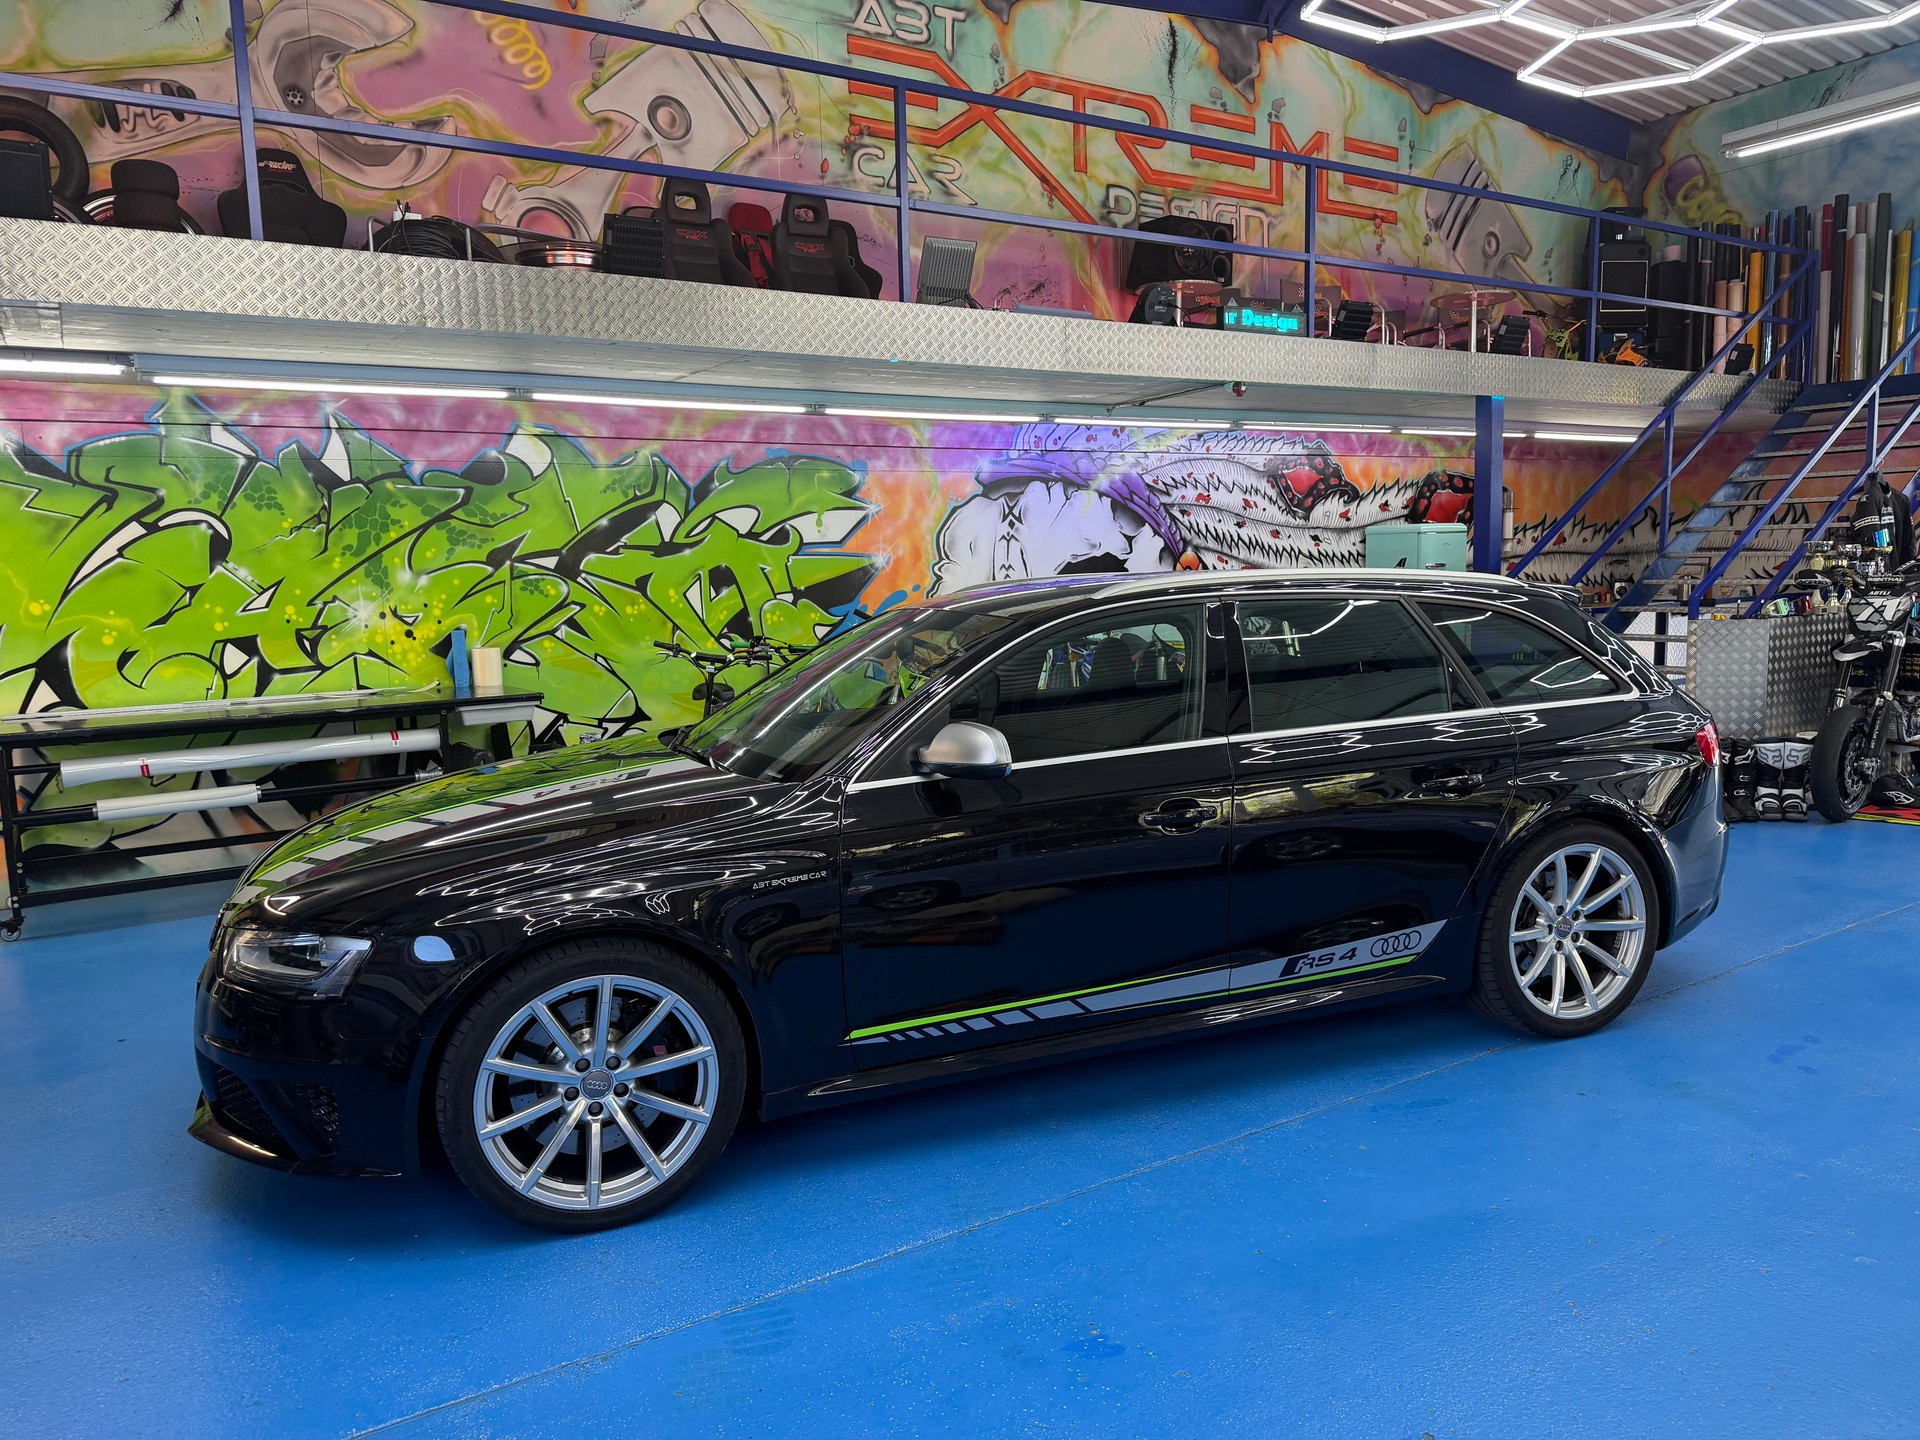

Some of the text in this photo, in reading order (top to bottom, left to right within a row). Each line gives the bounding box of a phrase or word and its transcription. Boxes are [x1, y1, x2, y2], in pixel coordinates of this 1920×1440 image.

[846, 34, 1398, 226] EXTREME
[853, 147, 978, 206] CAR
[1242, 309, 1298, 333] Design
[1855, 598, 1901, 622] 71
[771, 873, 809, 886] EXTREME
[808, 870, 827, 880] CAR
[1338, 946, 1358, 961] 4
